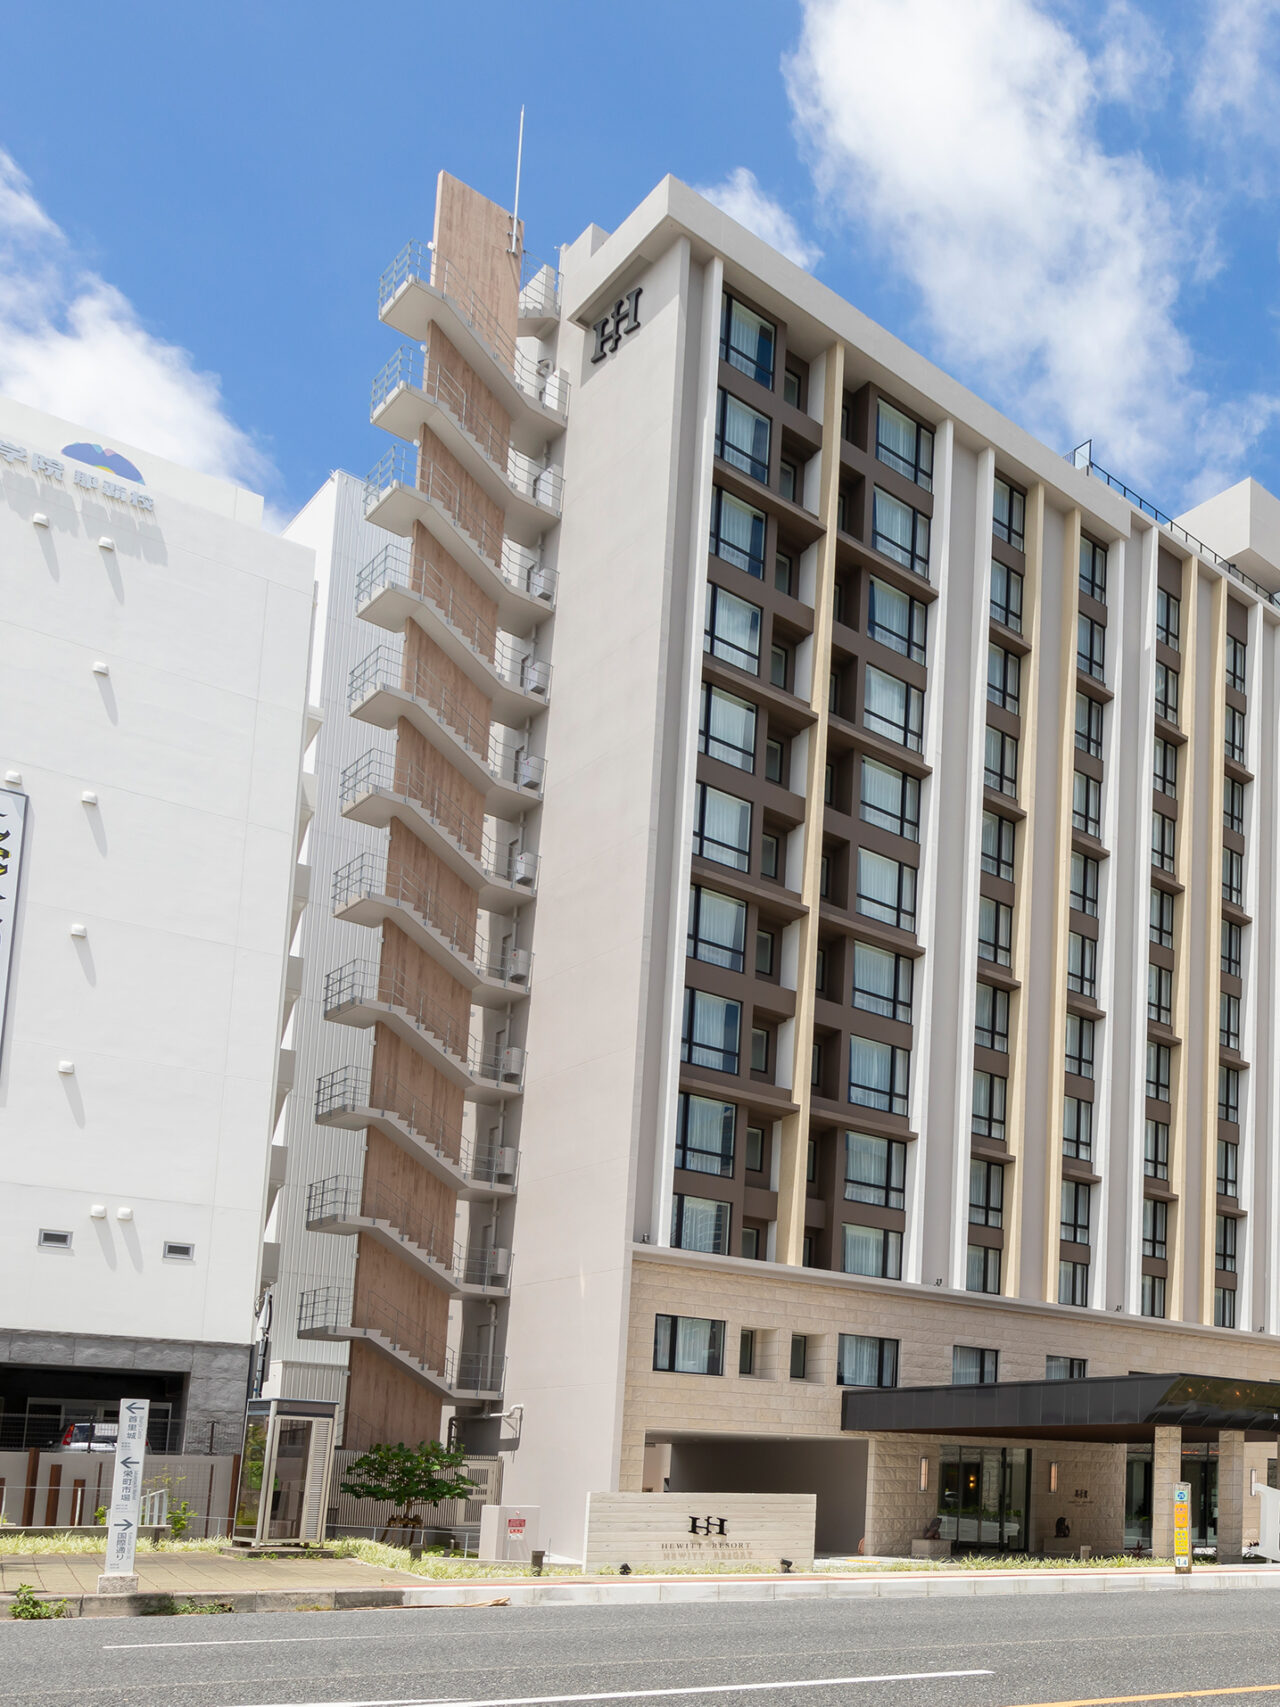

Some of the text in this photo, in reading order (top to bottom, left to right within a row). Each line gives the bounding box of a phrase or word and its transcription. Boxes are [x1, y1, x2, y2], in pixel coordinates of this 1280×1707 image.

[127, 1415, 138, 1440] 首里城
[116, 1531, 127, 1561] 国際通り
[712, 1542, 751, 1550] RESORT
